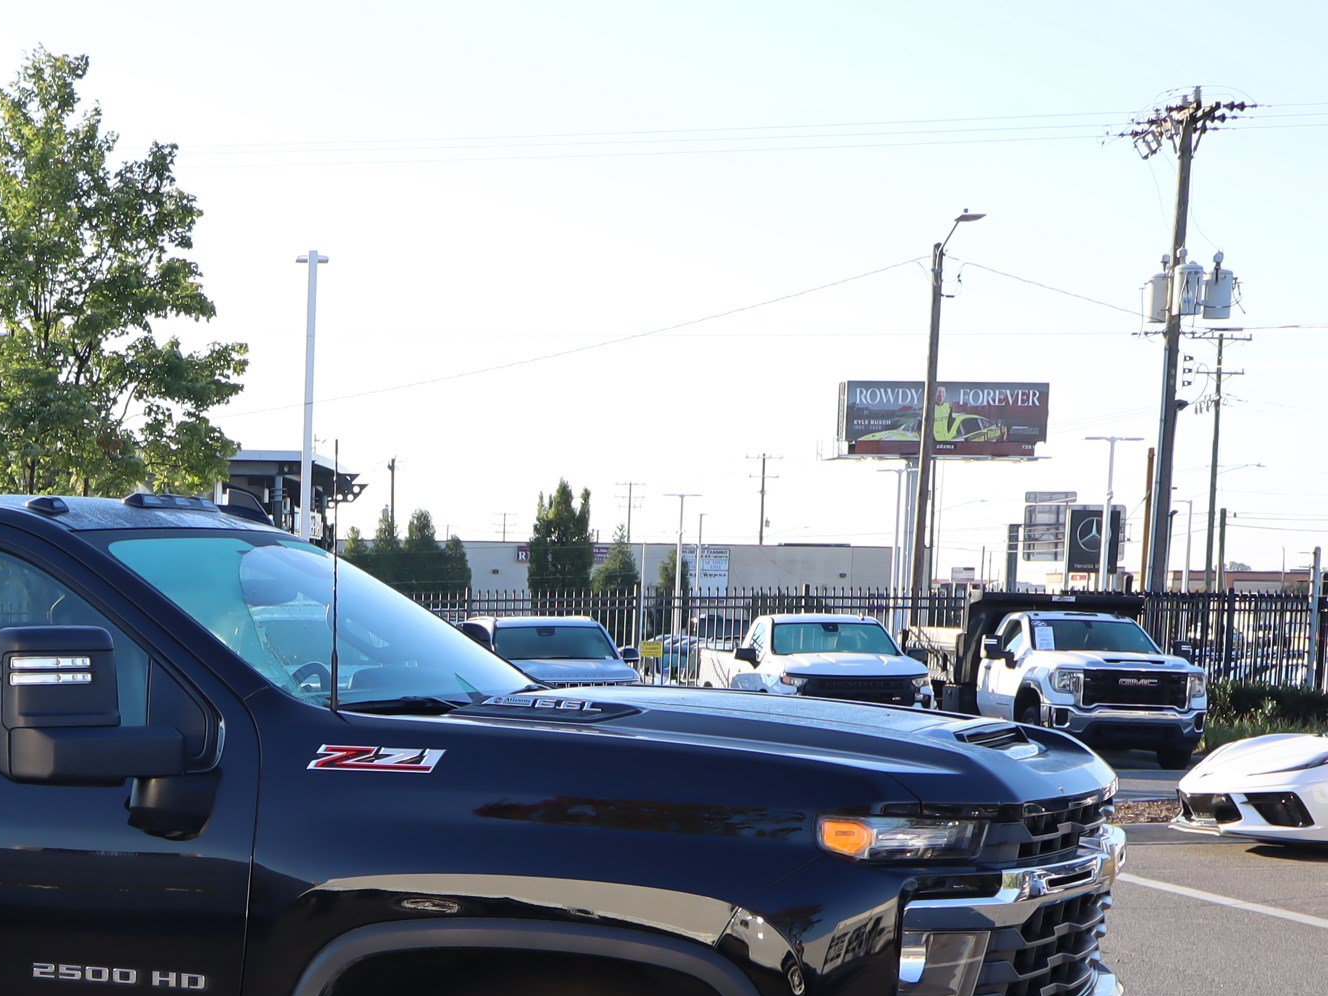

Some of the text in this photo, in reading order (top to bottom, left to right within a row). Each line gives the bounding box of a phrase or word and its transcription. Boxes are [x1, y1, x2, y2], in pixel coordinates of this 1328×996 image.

[856, 387, 1040, 407] ROWDY FOREVER
[1118, 678, 1159, 686] GMC
[306, 743, 448, 774] Z71
[32, 962, 207, 990] 2500 HD
